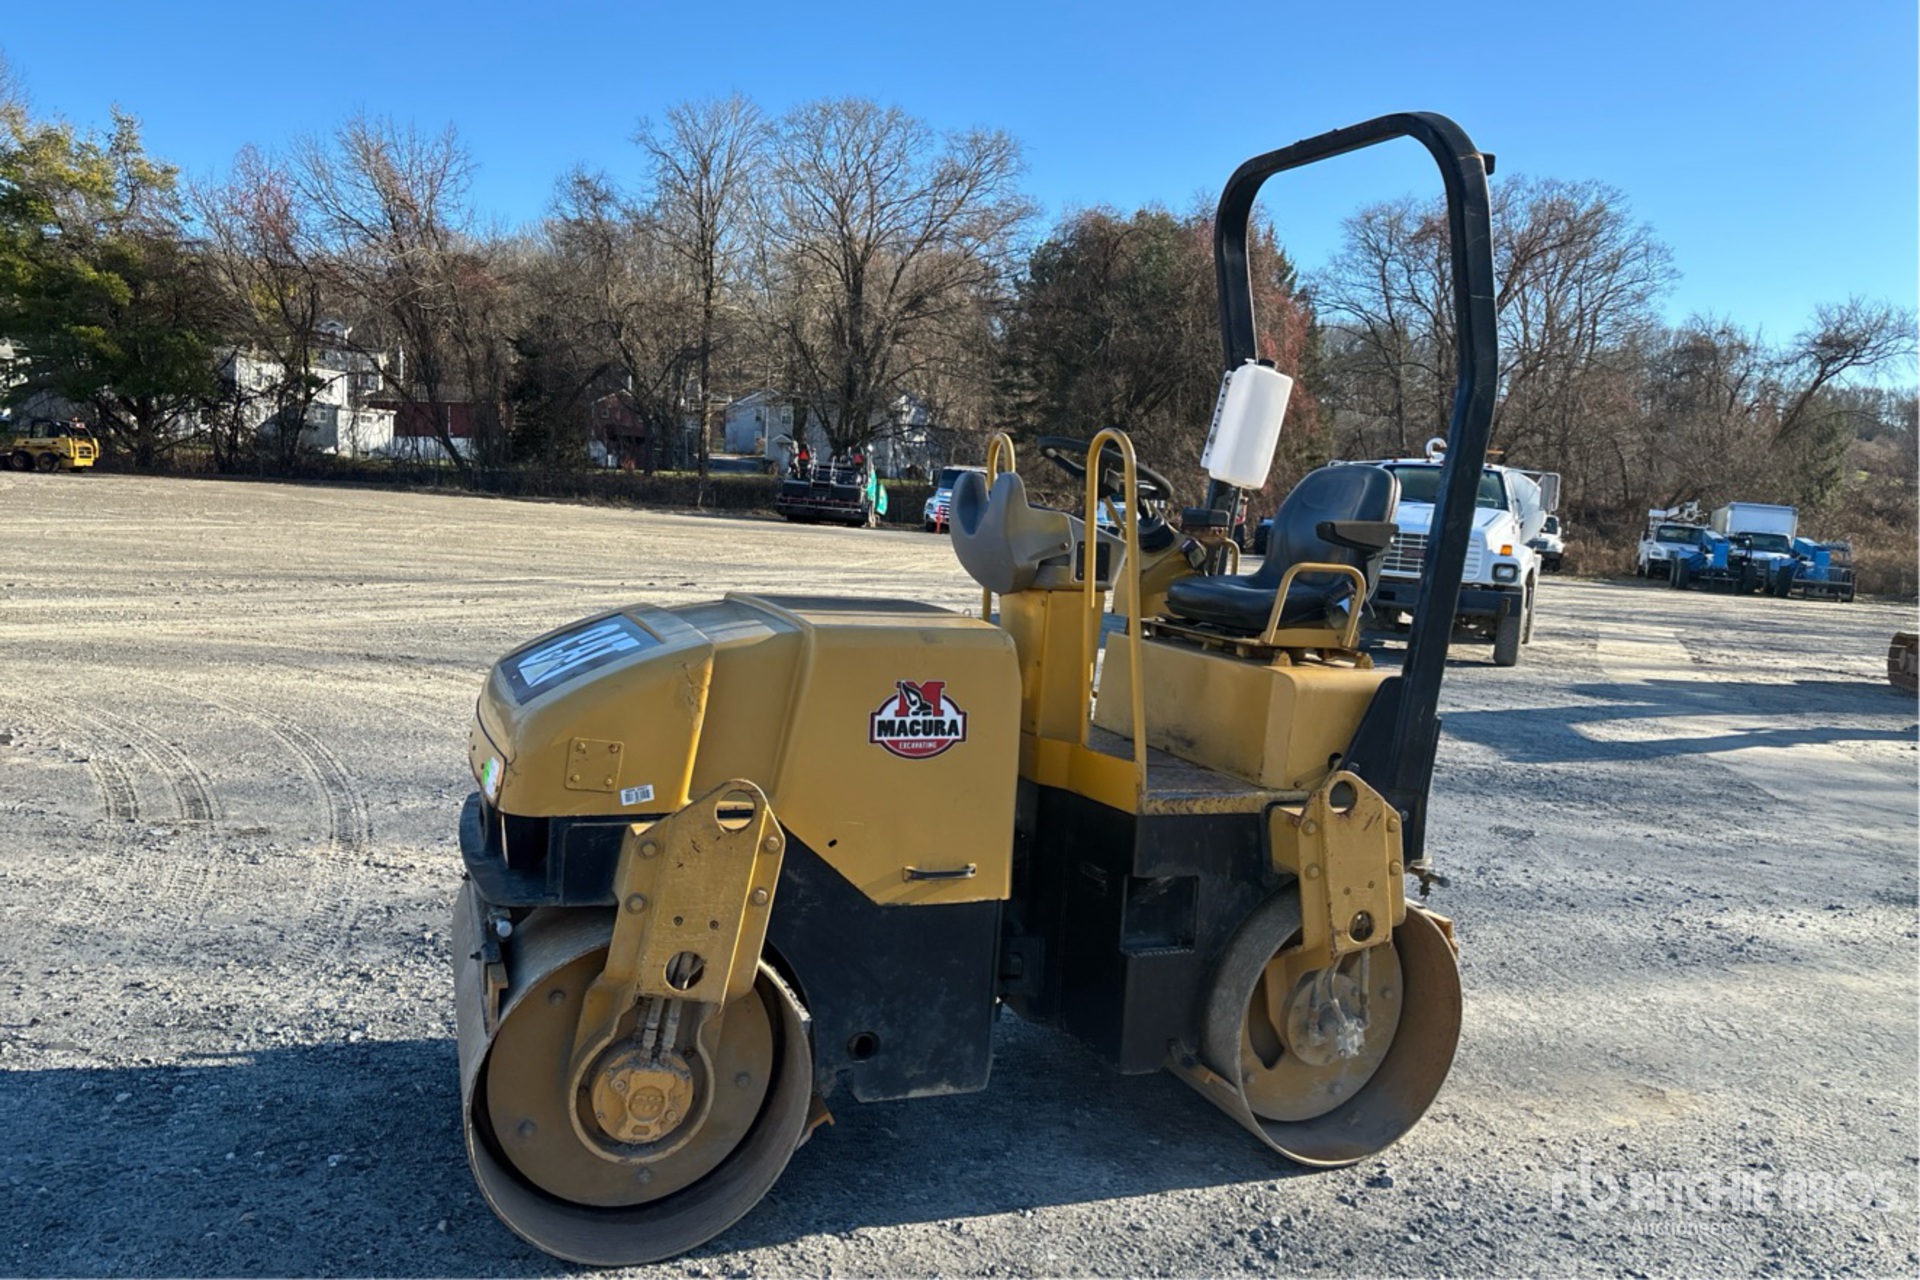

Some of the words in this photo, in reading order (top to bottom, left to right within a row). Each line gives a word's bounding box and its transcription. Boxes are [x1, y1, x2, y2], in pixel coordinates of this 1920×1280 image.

[518, 624, 641, 688] CAT
[877, 719, 960, 737] MACURA
[899, 741, 937, 750] EXCAVATING
